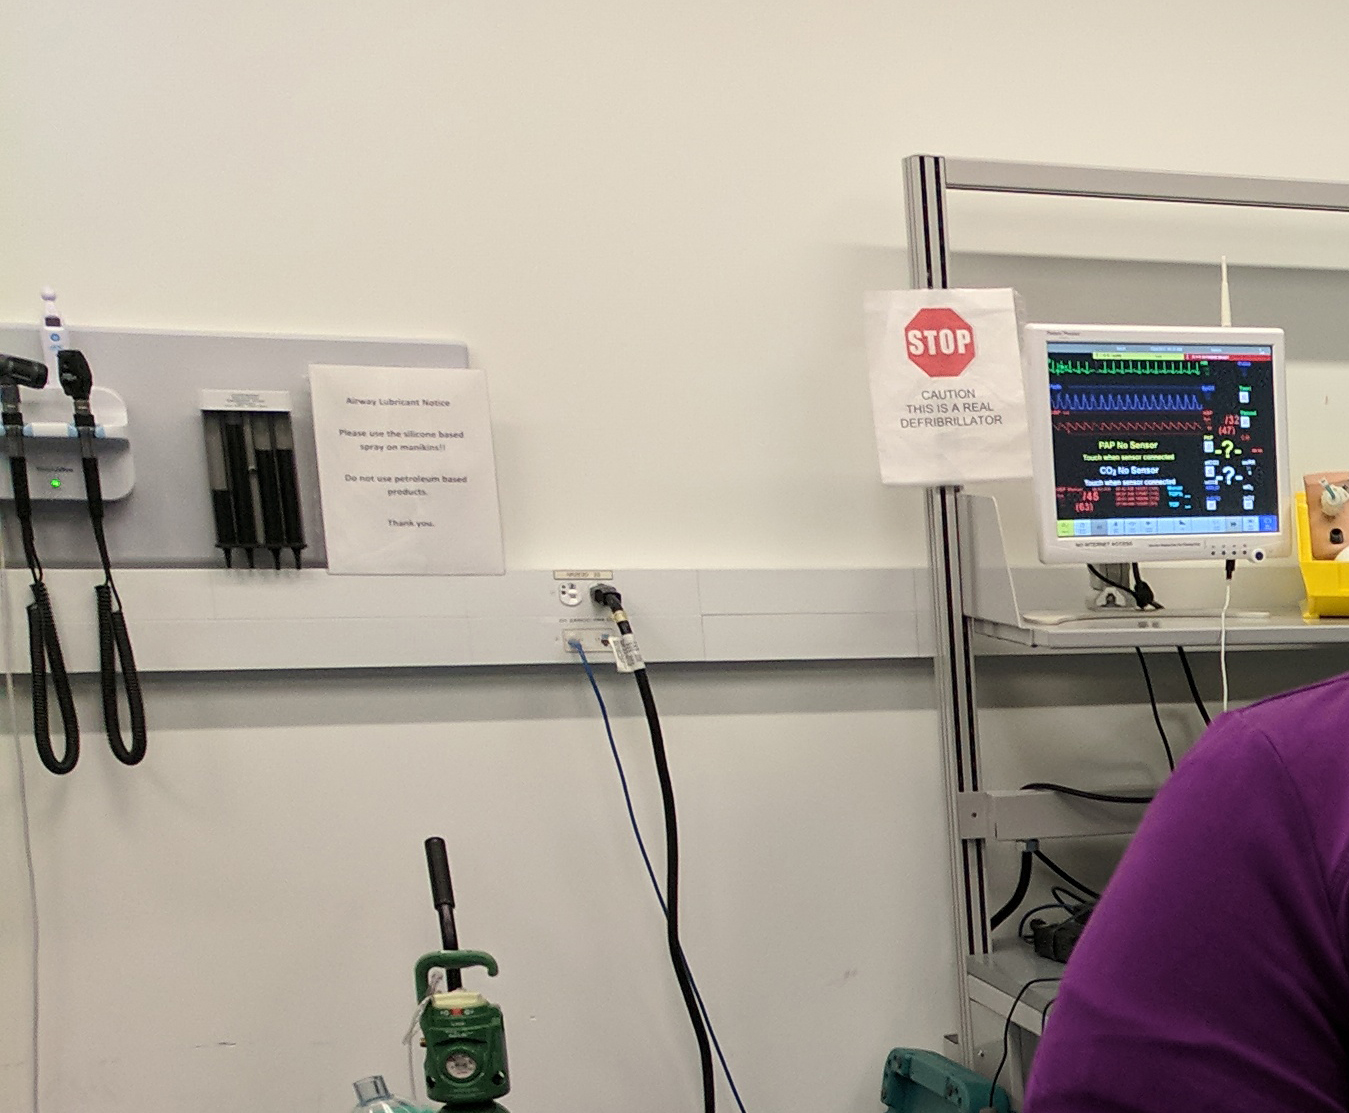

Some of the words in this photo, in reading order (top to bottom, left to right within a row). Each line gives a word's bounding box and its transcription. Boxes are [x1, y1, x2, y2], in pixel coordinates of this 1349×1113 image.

[907, 328, 971, 356] STOP
[921, 388, 976, 401] CAUTION
[346, 397, 377, 407] Airway
[379, 398, 420, 407] Lubricant
[422, 399, 451, 408] Notice
[907, 404, 934, 414] THIS
[937, 403, 949, 413] IS
[952, 403, 960, 413] A
[963, 402, 995, 413] REAL
[900, 415, 1003, 429] DEFRIBRILLATOR
[338, 428, 367, 438] Please
[369, 430, 385, 438] use
[386, 429, 402, 438] the
[403, 430, 436, 439] silicone
[438, 431, 465, 439] based
[360, 443, 384, 452] spray
[1098, 440, 1114, 450] PAP
[1116, 441, 1129, 450] No
[1130, 440, 1158, 450] Sensor
[1118, 466, 1130, 475] No
[1131, 466, 1159, 475] Sensor
[344, 474, 358, 483] Do
[359, 475, 375, 483] not
[377, 475, 392, 484] use
[394, 474, 440, 485] petroleum
[442, 475, 468, 484] based
[388, 519, 414, 528] Thank
